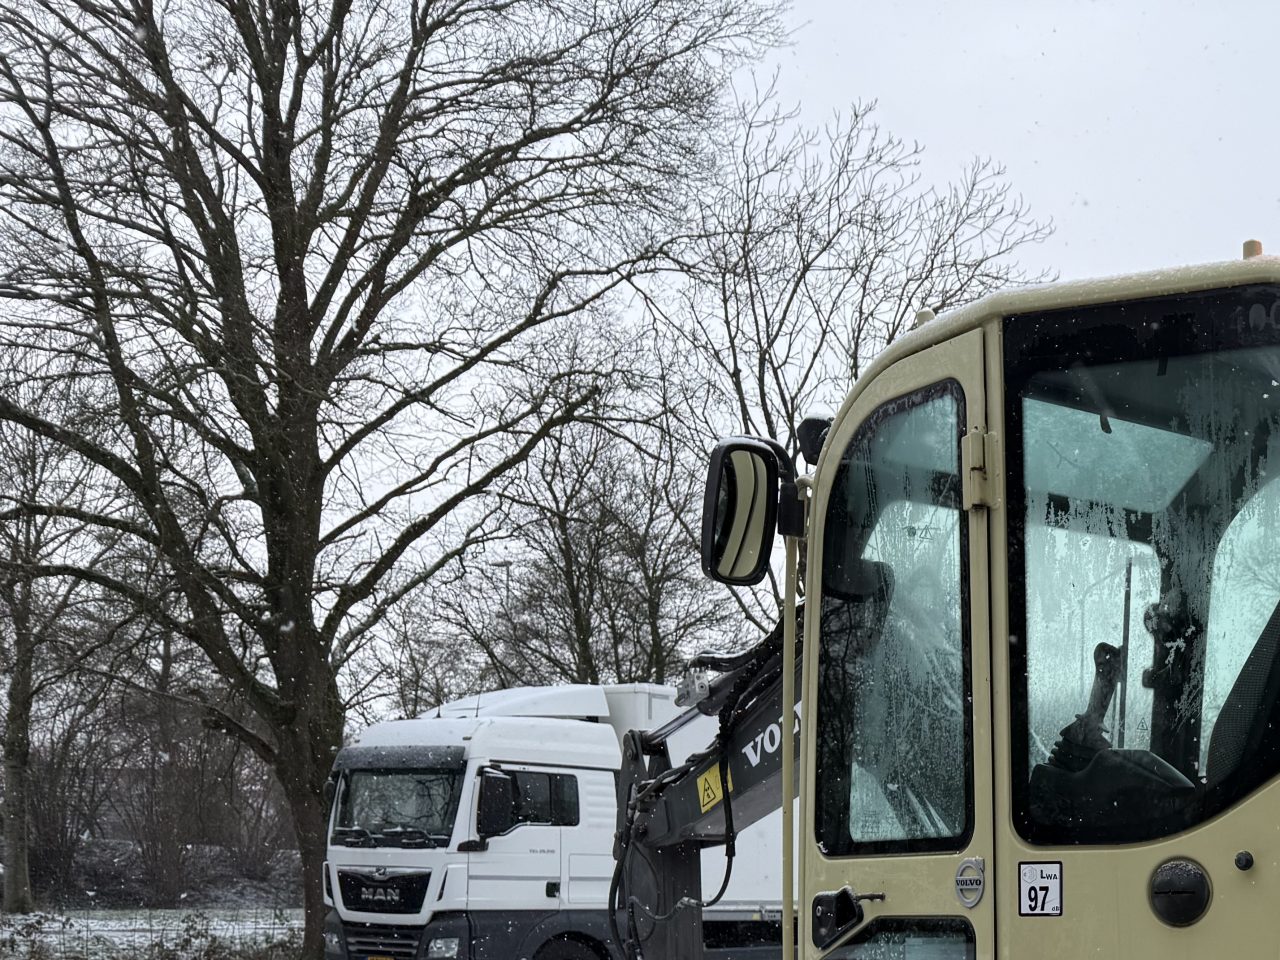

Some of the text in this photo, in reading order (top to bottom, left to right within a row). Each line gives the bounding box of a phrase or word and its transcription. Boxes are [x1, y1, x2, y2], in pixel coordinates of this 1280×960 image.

[956, 879, 982, 887] VOLVO
[361, 887, 400, 900] MAN
[1028, 885, 1050, 912] 97
